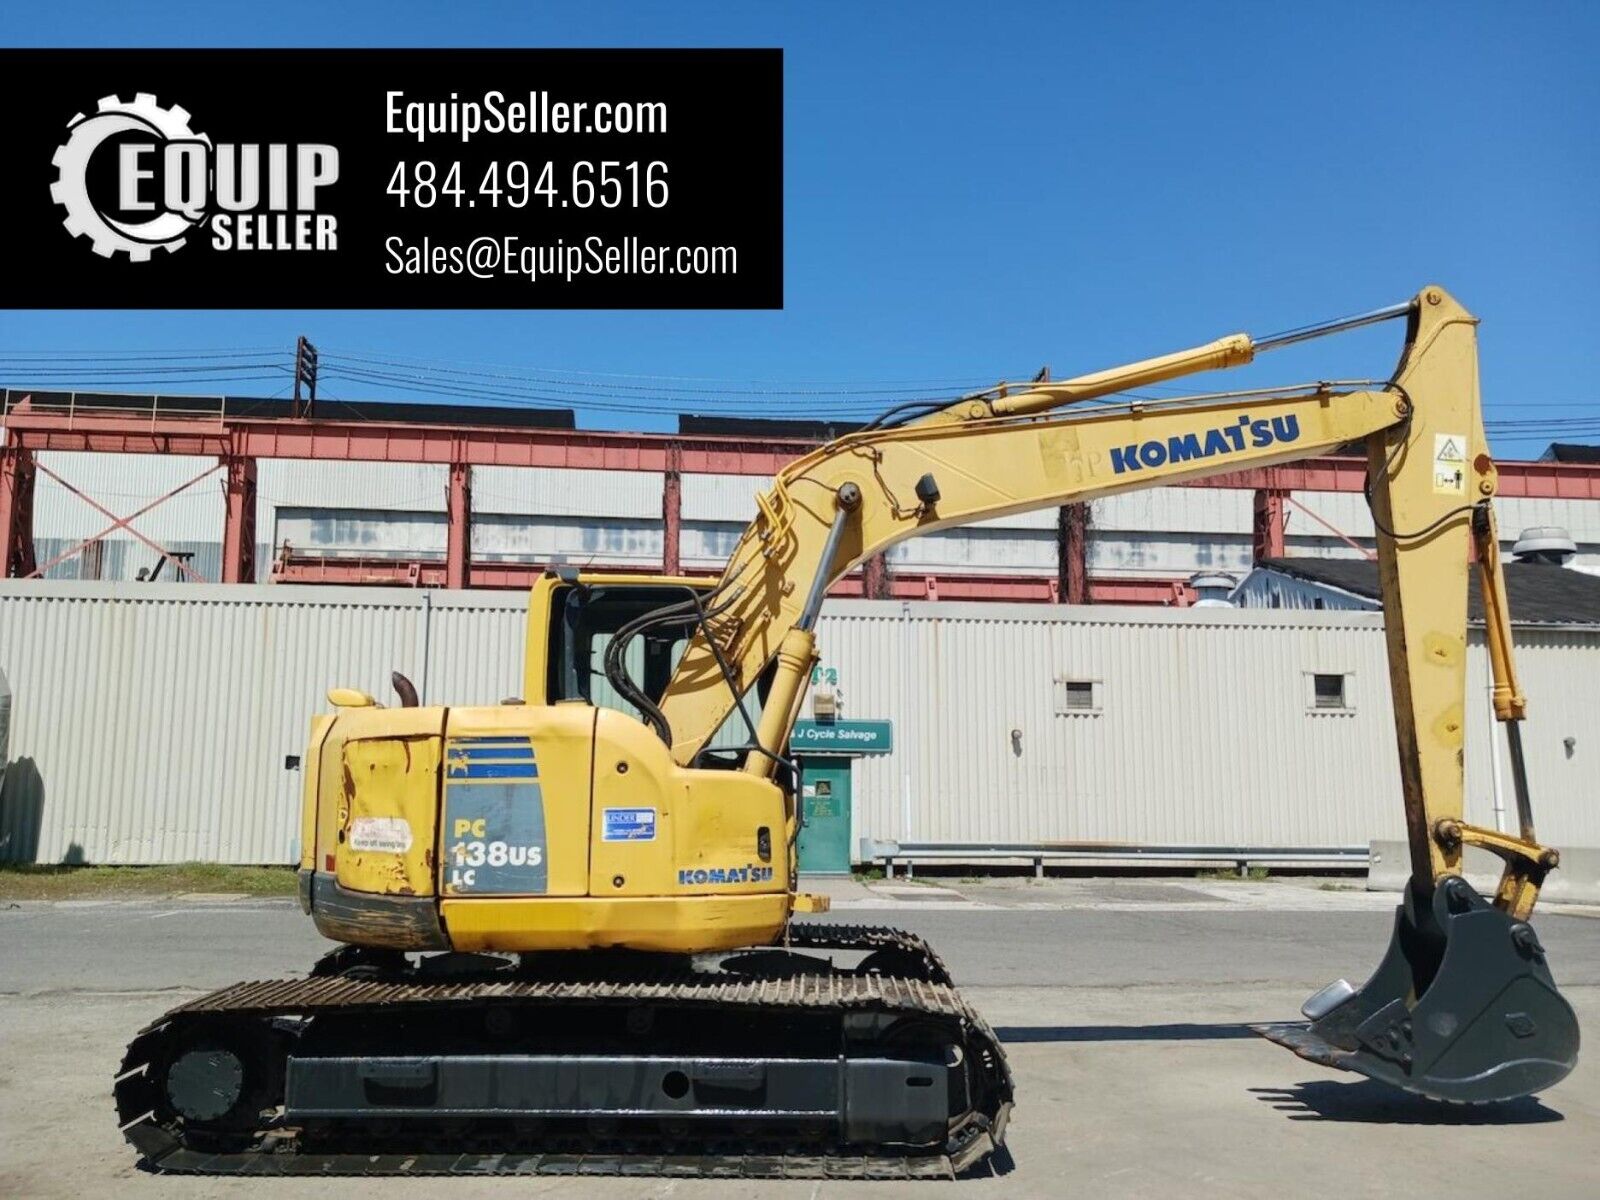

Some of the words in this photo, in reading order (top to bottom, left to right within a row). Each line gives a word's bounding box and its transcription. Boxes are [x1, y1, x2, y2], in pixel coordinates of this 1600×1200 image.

[1110, 414, 1300, 474] KOMATSU
[806, 728, 835, 741] Cycle
[838, 729, 877, 742] Salvage
[454, 818, 486, 838] PC
[452, 869, 476, 886] LC
[679, 863, 772, 884] KOMATSU
